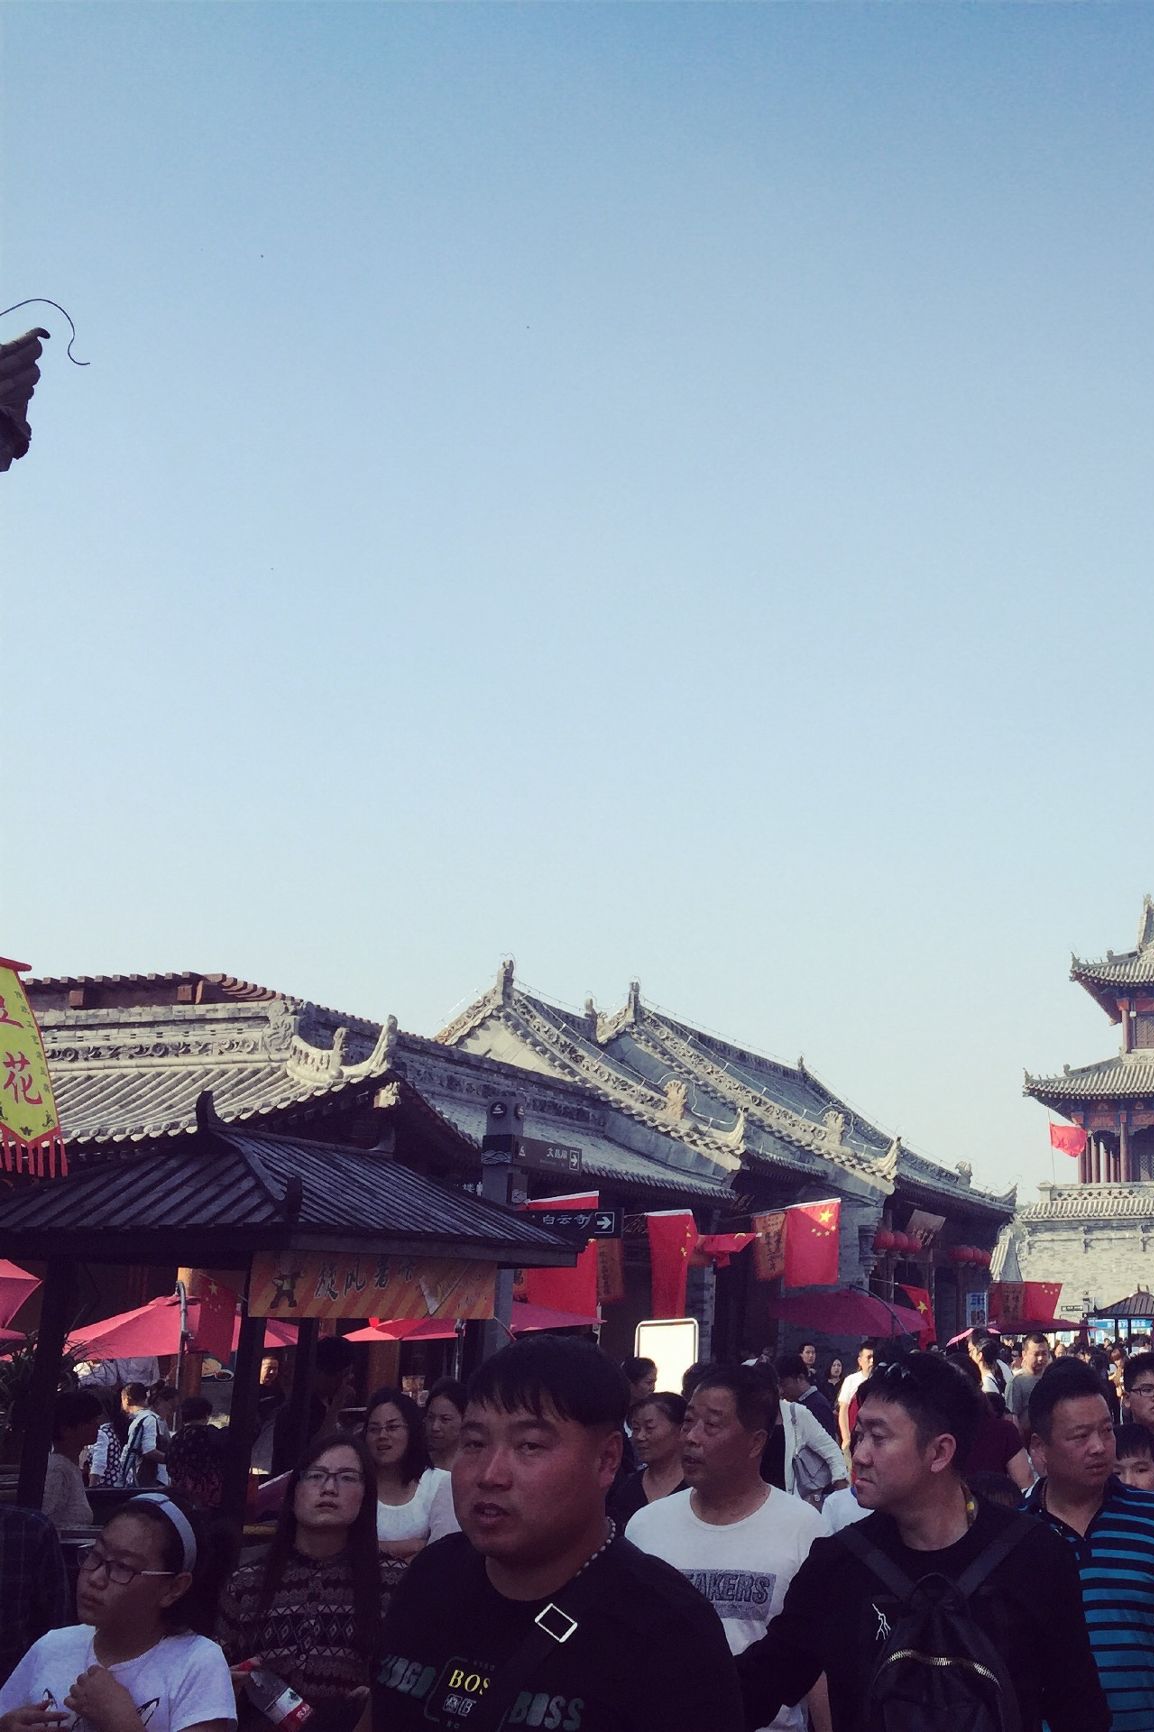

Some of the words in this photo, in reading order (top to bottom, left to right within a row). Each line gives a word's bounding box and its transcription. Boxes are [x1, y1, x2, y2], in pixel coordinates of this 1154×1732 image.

[542, 1213, 594, 1230] 白云寺
[509, 1691, 584, 1731] BOSS
